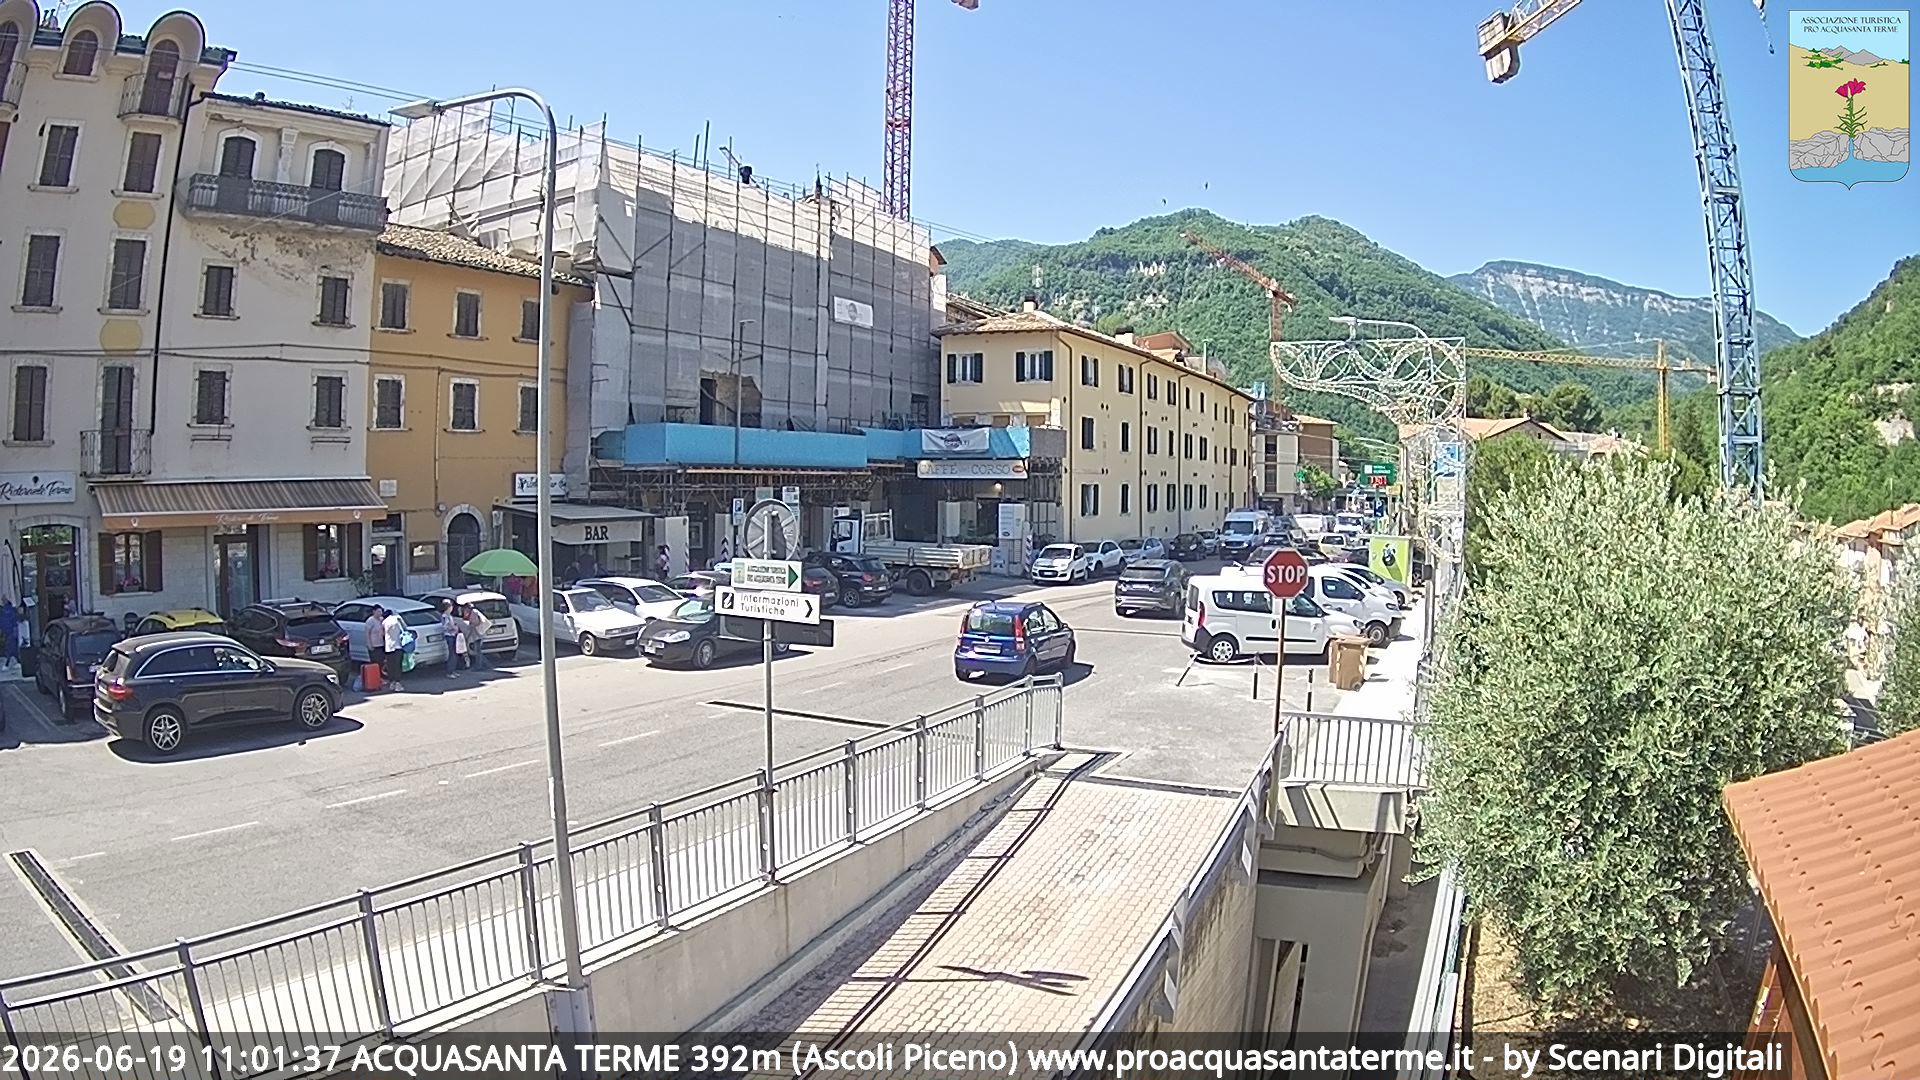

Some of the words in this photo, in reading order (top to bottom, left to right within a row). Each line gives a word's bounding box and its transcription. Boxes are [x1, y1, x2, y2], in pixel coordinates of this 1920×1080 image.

[971, 463, 1011, 475] CORSO
[584, 525, 609, 541] BAR
[1267, 565, 1306, 584] STOP
[740, 593, 799, 608] Informazioni
